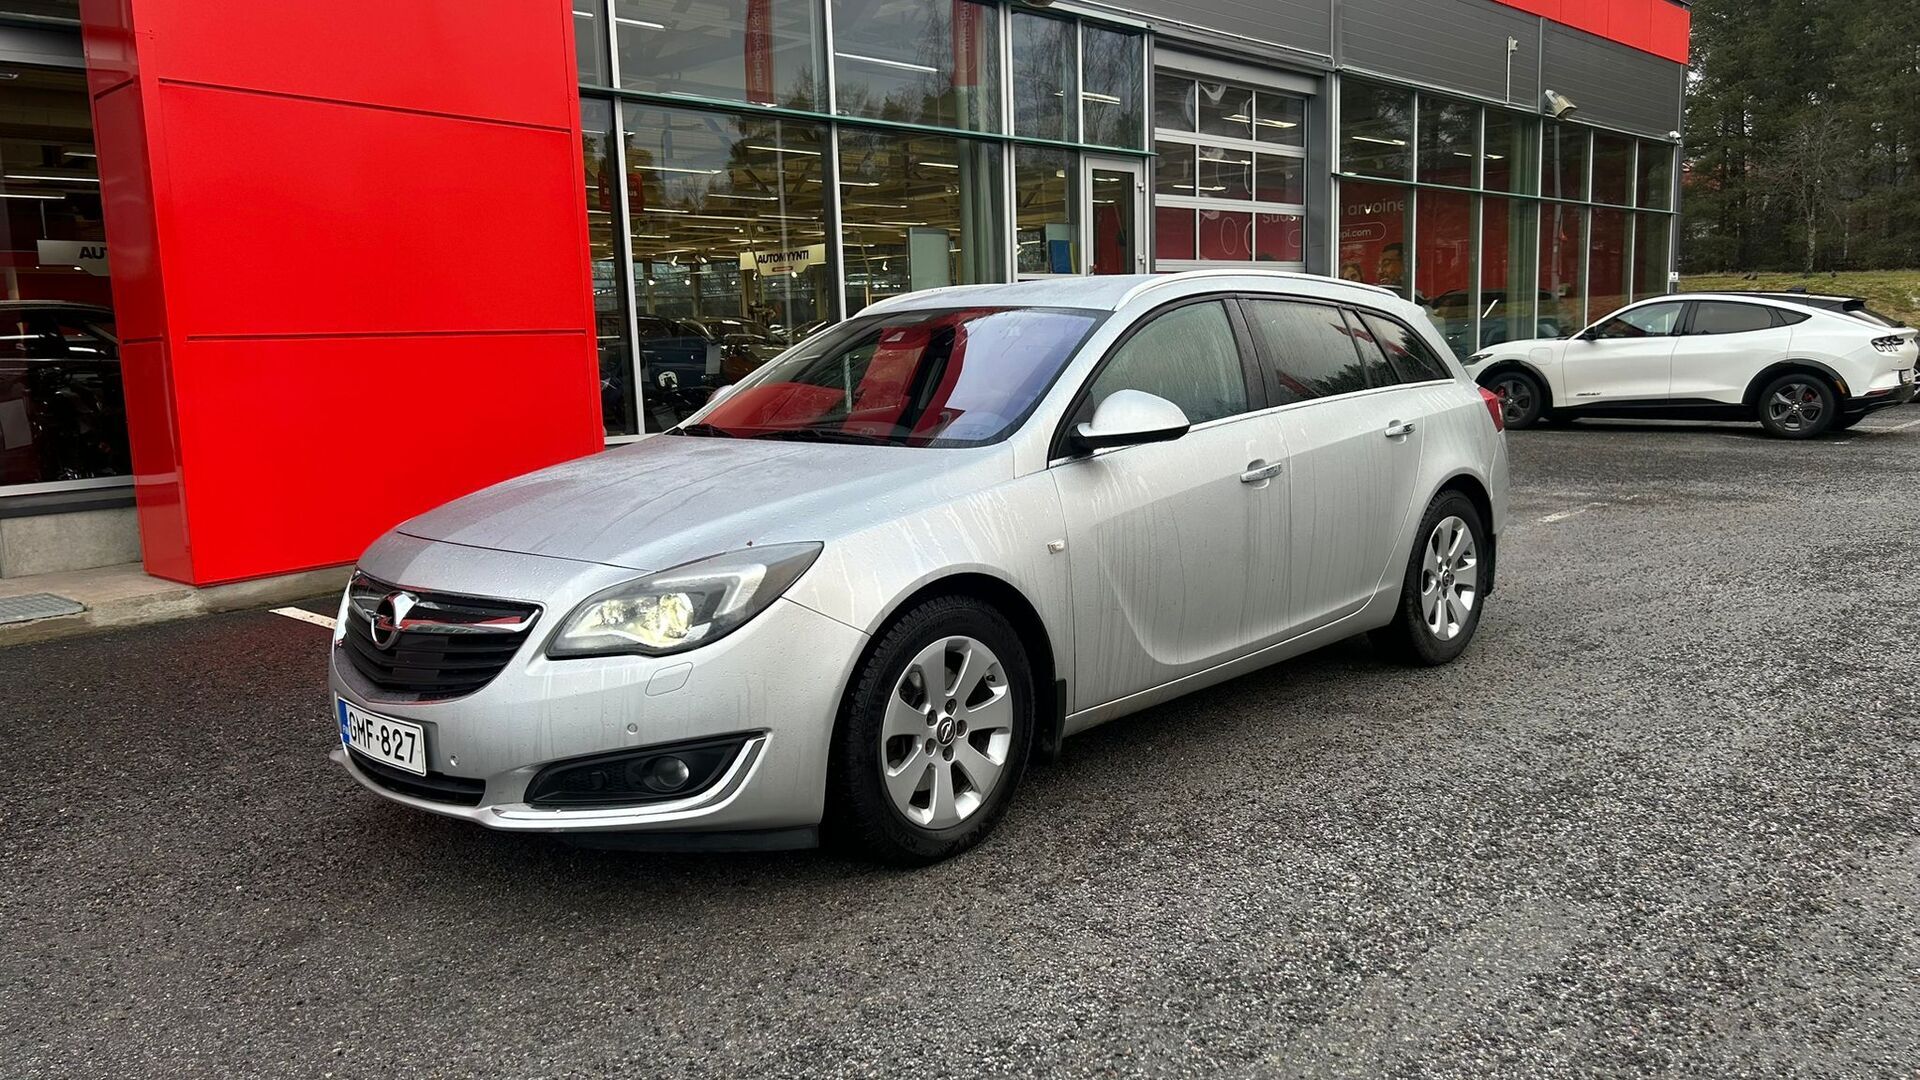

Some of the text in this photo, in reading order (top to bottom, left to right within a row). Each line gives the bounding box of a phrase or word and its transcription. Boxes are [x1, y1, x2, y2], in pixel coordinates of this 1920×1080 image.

[1340, 229, 1372, 241] pi.com
[79, 246, 107, 259] AU
[758, 250, 809, 264] AUTOMYYNTI
[349, 711, 416, 764] GMF-827
